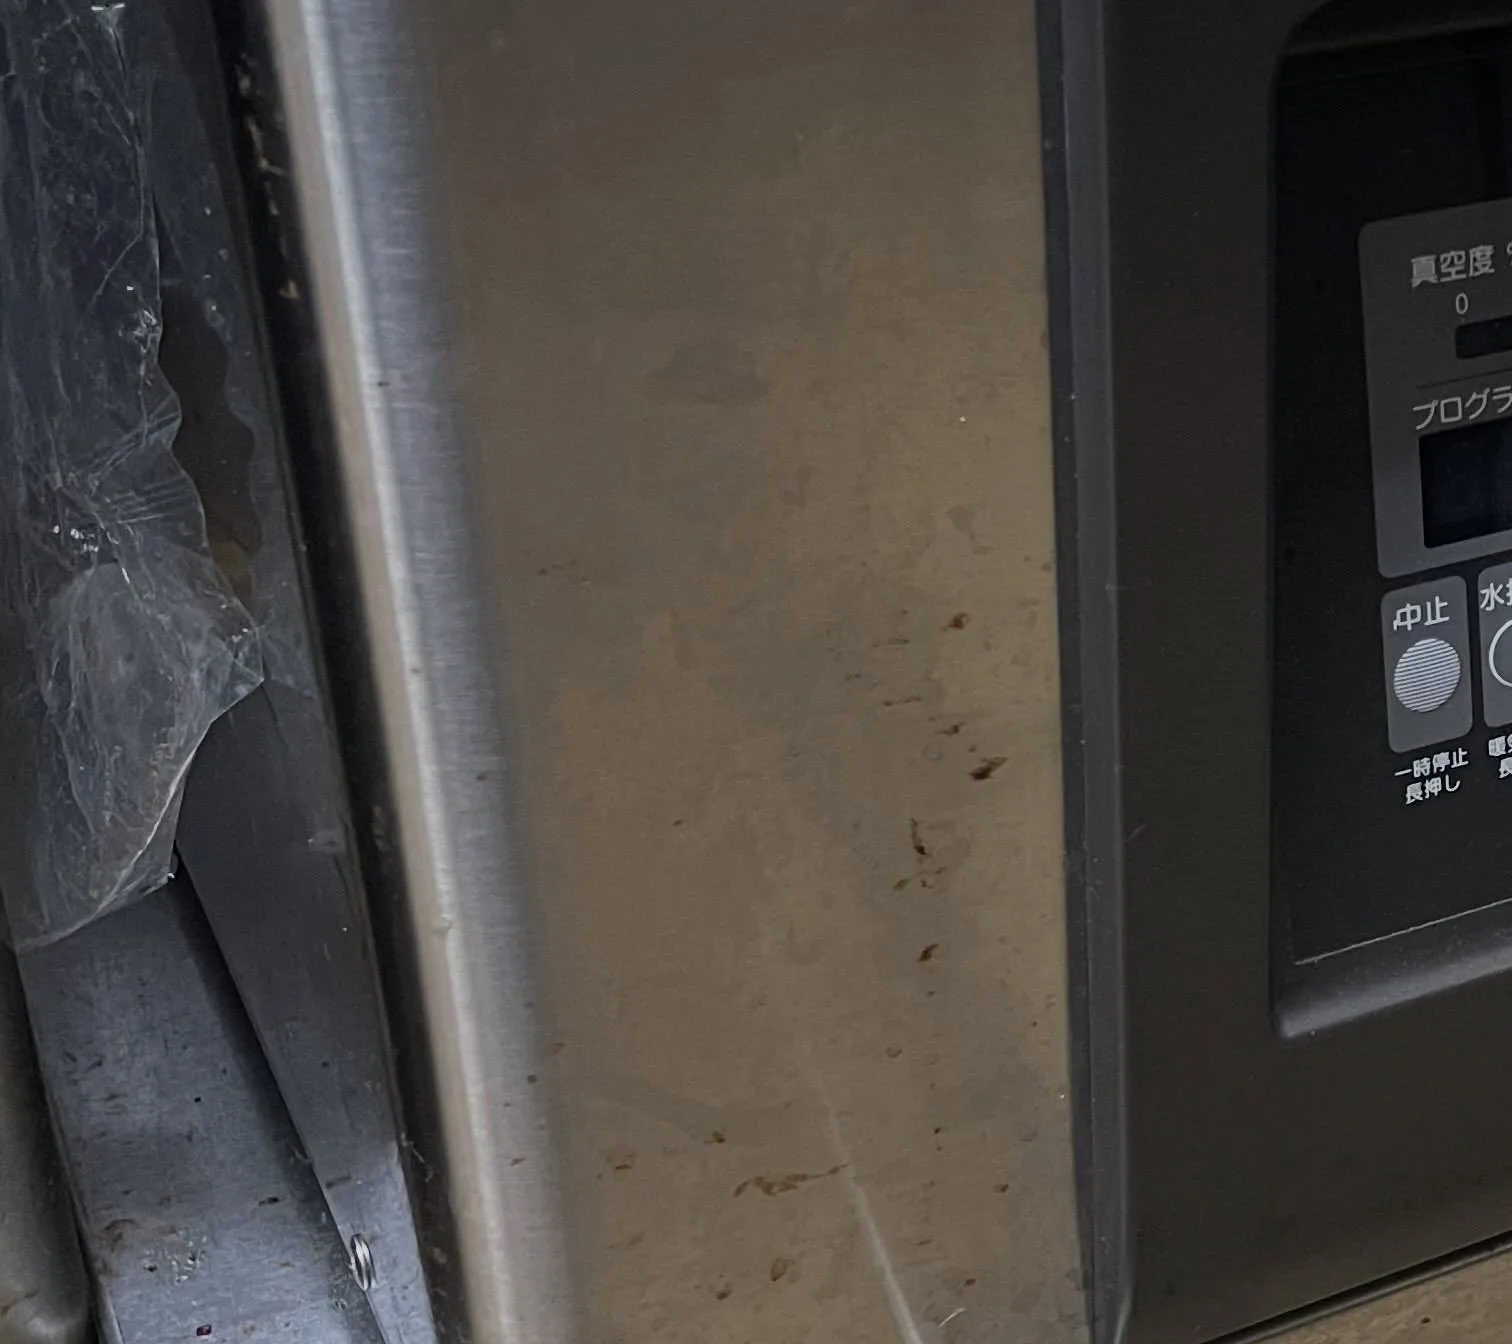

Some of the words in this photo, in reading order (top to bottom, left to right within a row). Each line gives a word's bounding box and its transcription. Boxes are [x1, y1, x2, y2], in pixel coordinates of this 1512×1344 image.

[1410, 243, 1495, 288] 真空度
[1455, 292, 1469, 316] 0
[1392, 595, 1451, 633] 中止
[1394, 747, 1469, 778] 一時停止
[1405, 774, 1461, 805] 長押し
